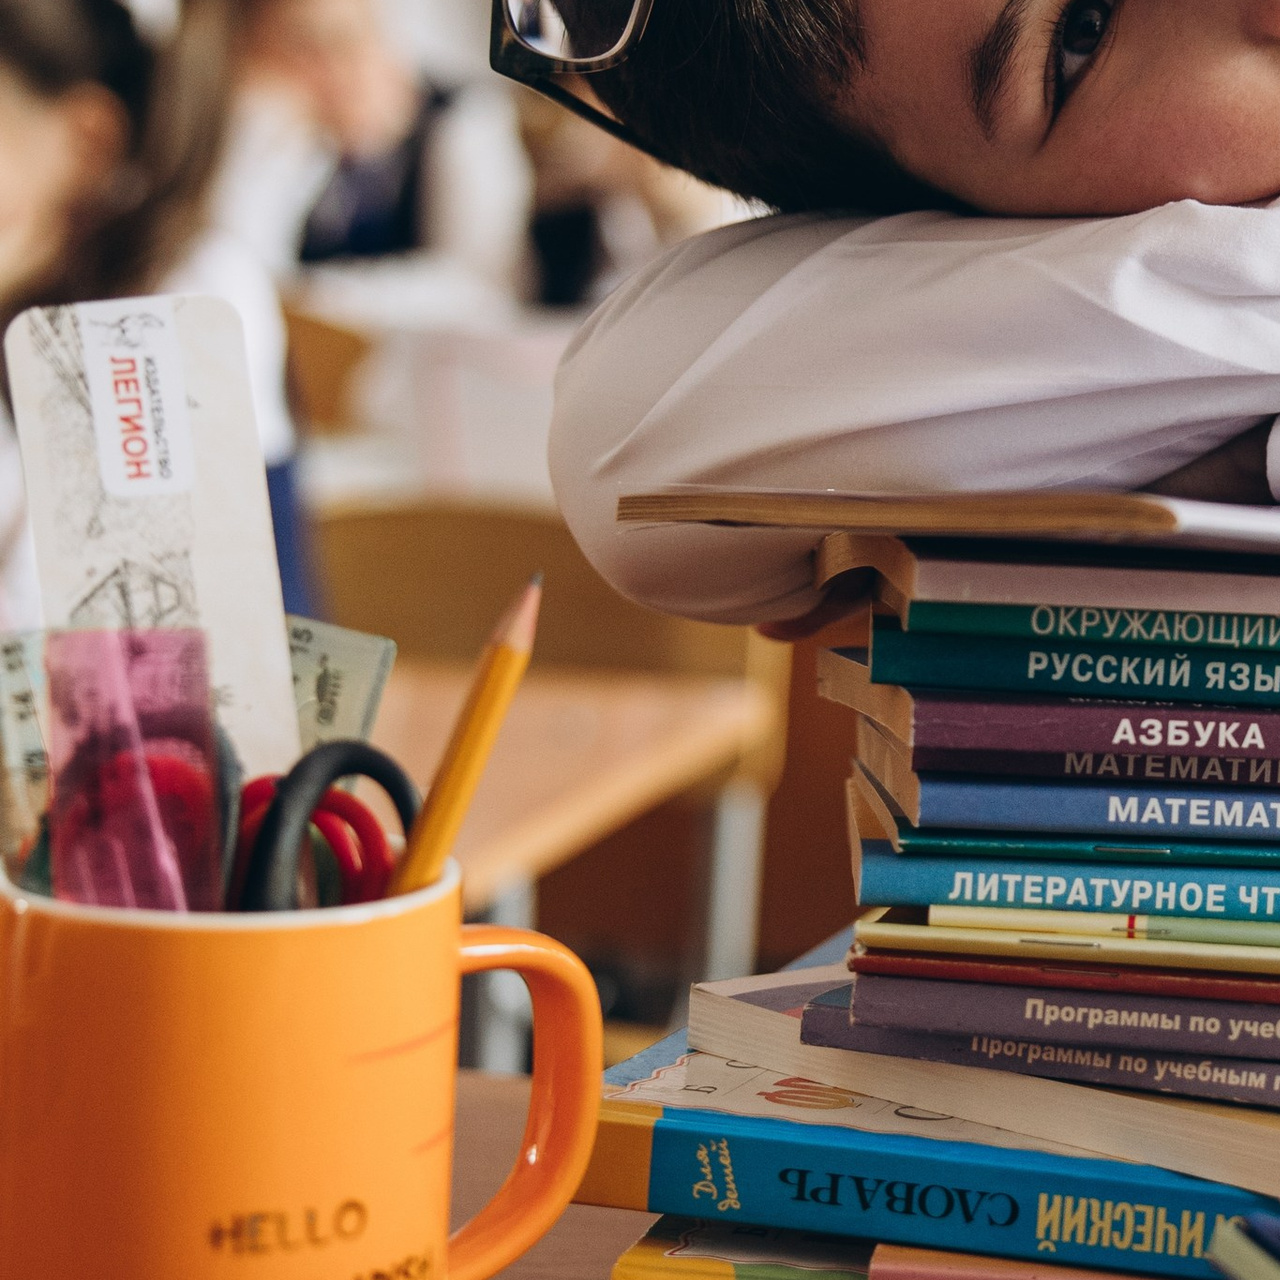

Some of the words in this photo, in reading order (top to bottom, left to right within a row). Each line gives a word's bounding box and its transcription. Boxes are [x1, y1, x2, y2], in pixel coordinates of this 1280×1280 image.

[109, 356, 153, 481] ЛЕГИОН
[144, 356, 173, 480] ИЗДАТЕЛЬСТВО
[1026, 650, 1192, 689] РУССКИЙ
[1111, 718, 1266, 750] АЗБУКА
[948, 870, 1227, 914] ЛИТЕРАТУРНОЕ
[1024, 997, 1181, 1031] Программы
[1189, 1015, 1221, 1036] по
[971, 1035, 1112, 1070] Программы
[1118, 1052, 1148, 1074] по
[1154, 1060, 1267, 1090] учебным
[692, 1143, 719, 1201] Для
[711, 1137, 742, 1212] детей
[778, 1167, 1020, 1228] СЛОВАРЬ
[208, 1197, 369, 1255] HELLO
